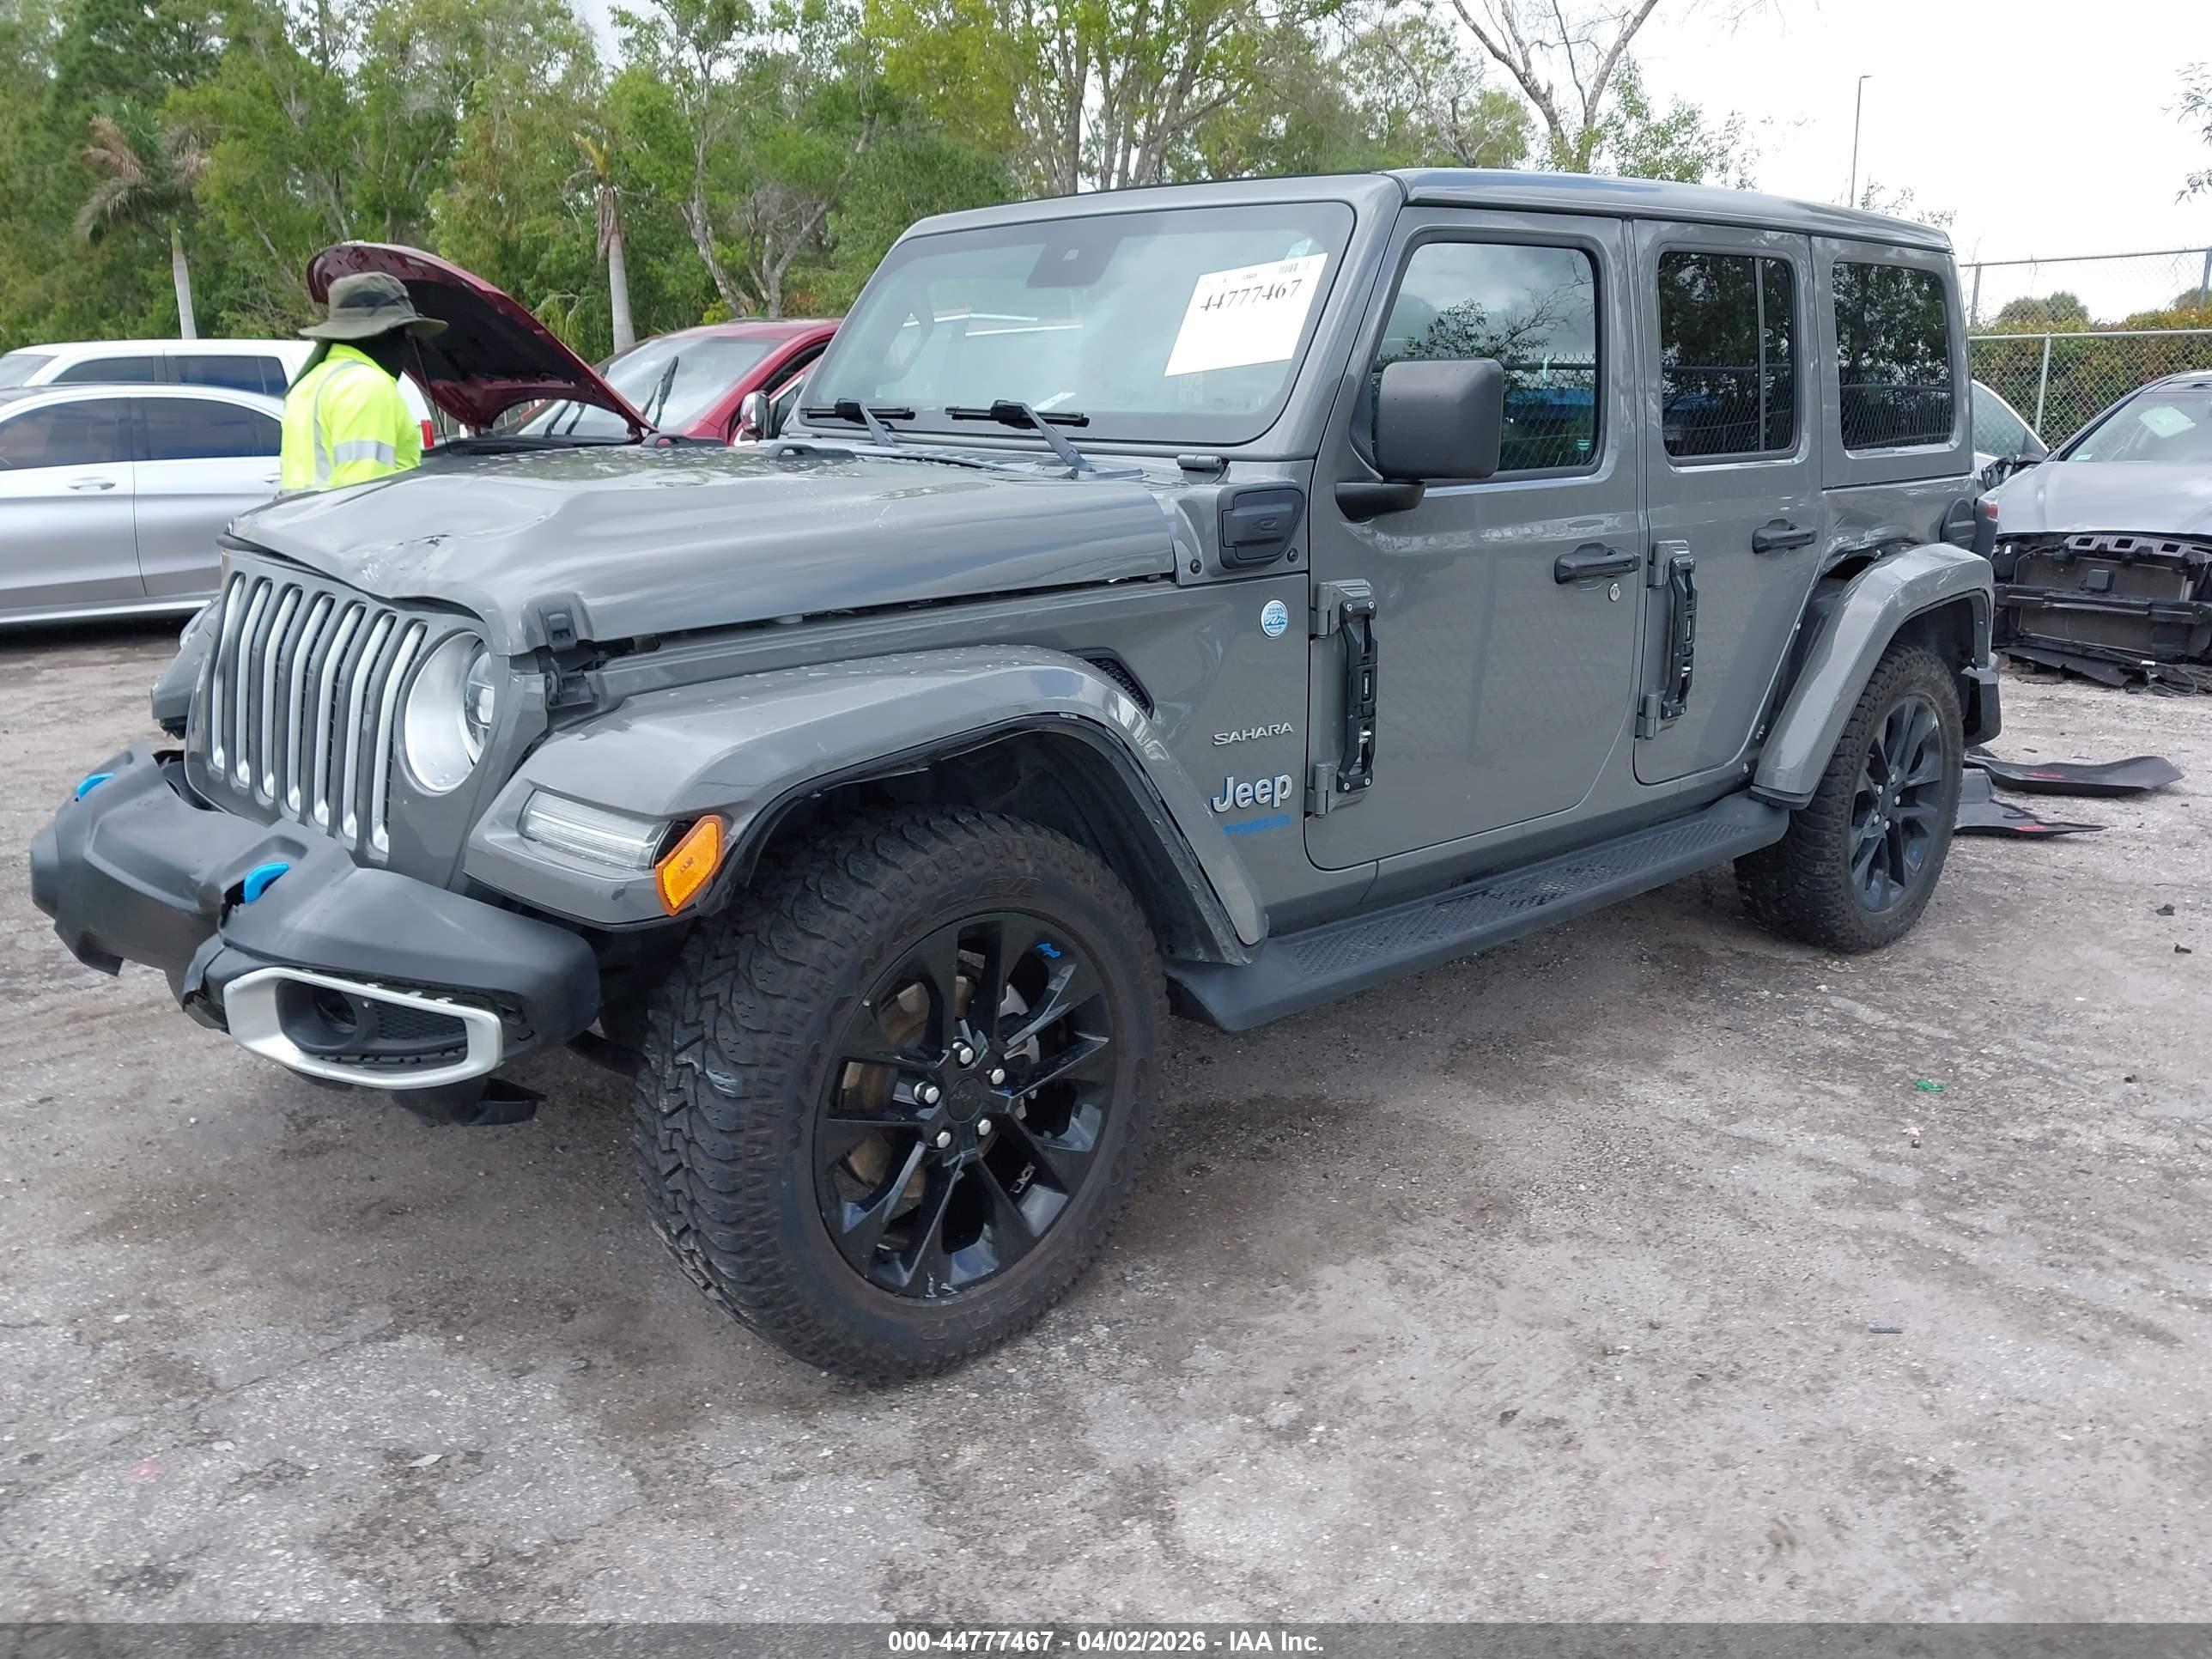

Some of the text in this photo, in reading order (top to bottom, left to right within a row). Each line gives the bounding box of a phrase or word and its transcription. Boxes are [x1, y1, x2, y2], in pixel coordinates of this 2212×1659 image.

[1200, 279, 1302, 311] 44777467
[1212, 722, 1293, 745] SAHARA
[1211, 775, 1292, 812] Jeep
